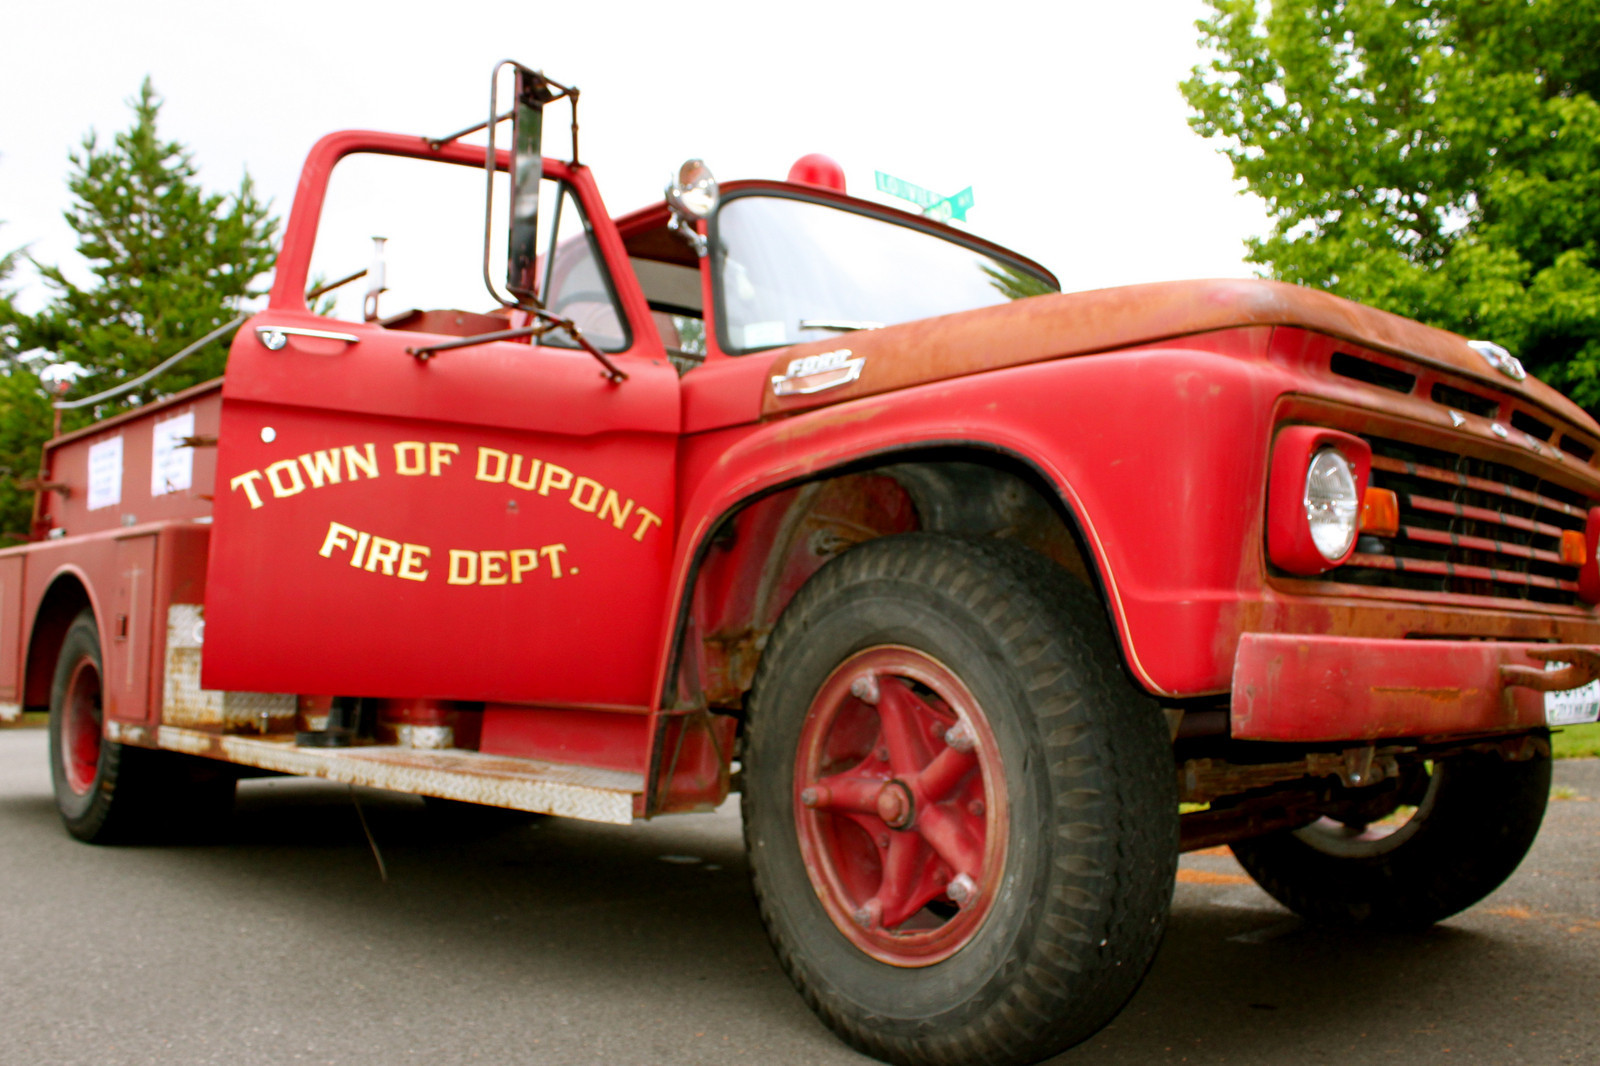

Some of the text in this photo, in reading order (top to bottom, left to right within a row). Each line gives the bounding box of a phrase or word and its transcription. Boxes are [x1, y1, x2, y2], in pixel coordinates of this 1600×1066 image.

[230, 443, 381, 510] TOWN
[393, 441, 460, 477] OF
[474, 446, 662, 542] DUPONT
[318, 521, 580, 586] FIRE DEPT.
